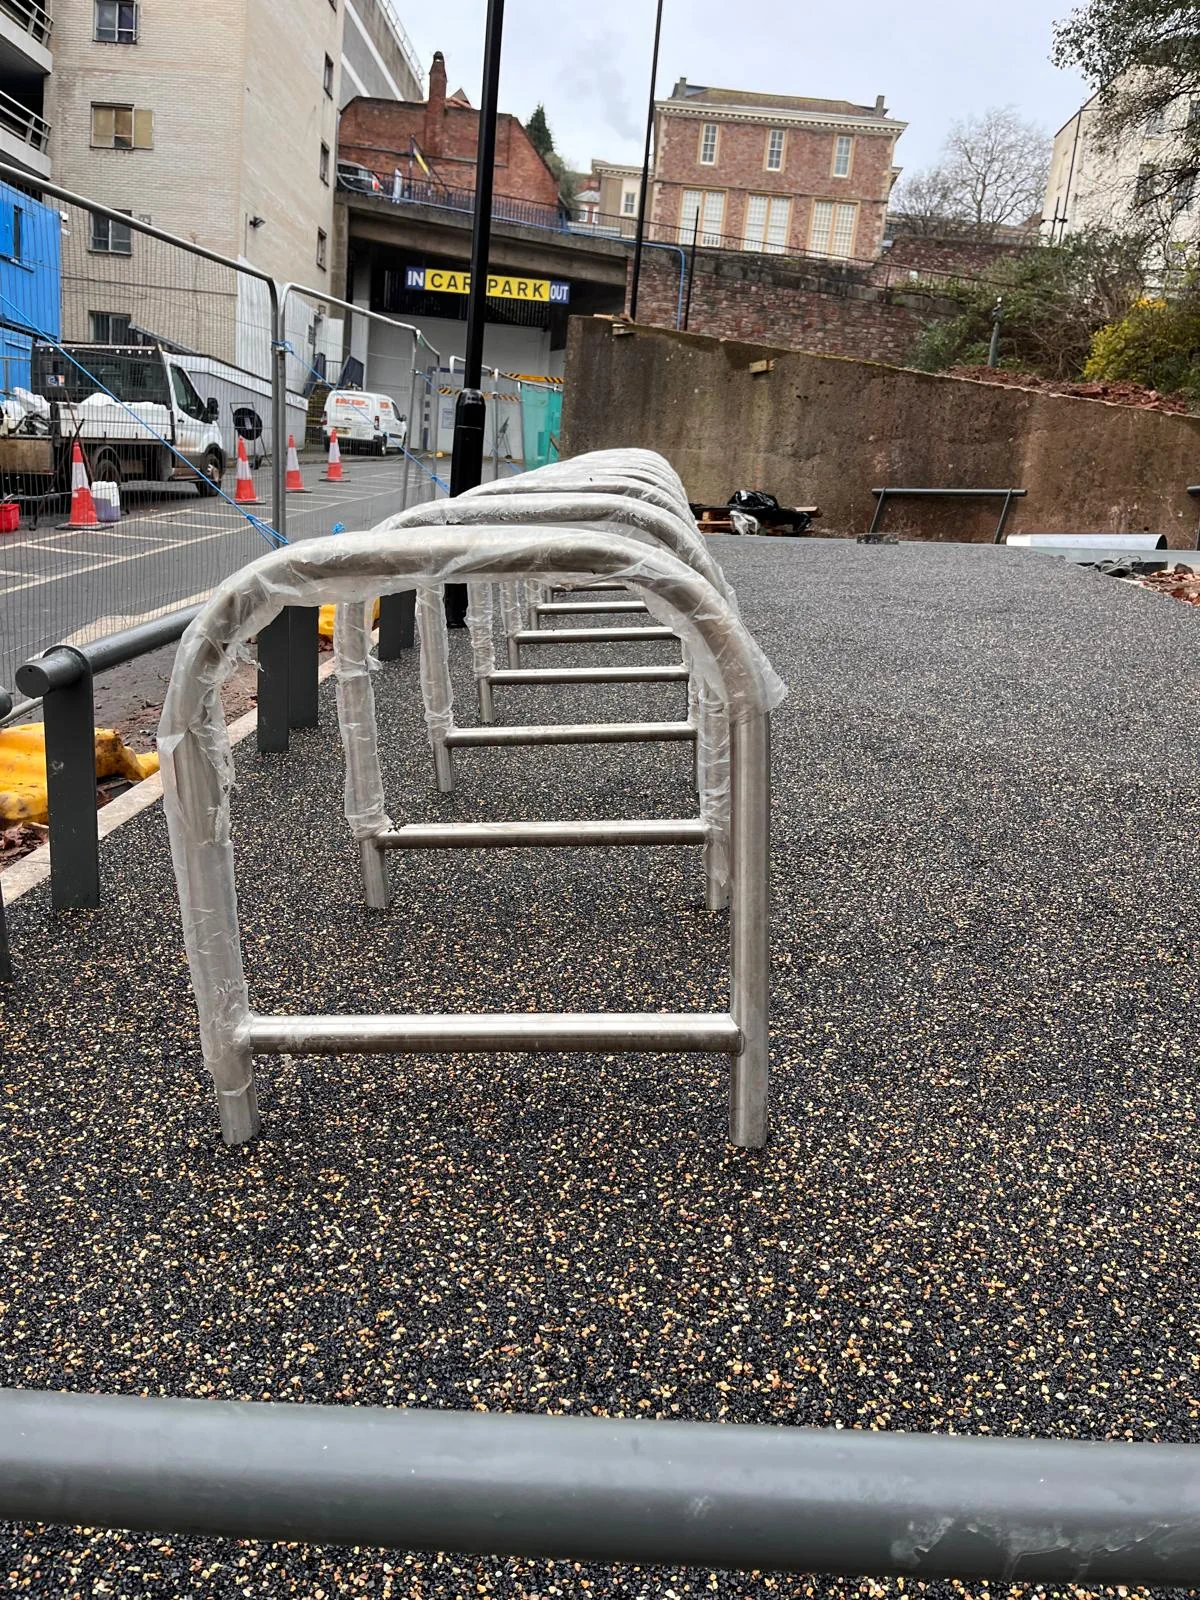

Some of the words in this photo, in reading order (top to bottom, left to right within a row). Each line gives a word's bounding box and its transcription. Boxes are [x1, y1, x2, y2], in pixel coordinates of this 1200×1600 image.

[407, 270, 424, 287] IN
[488, 278, 544, 299] PARK
[550, 284, 569, 301] OUT
